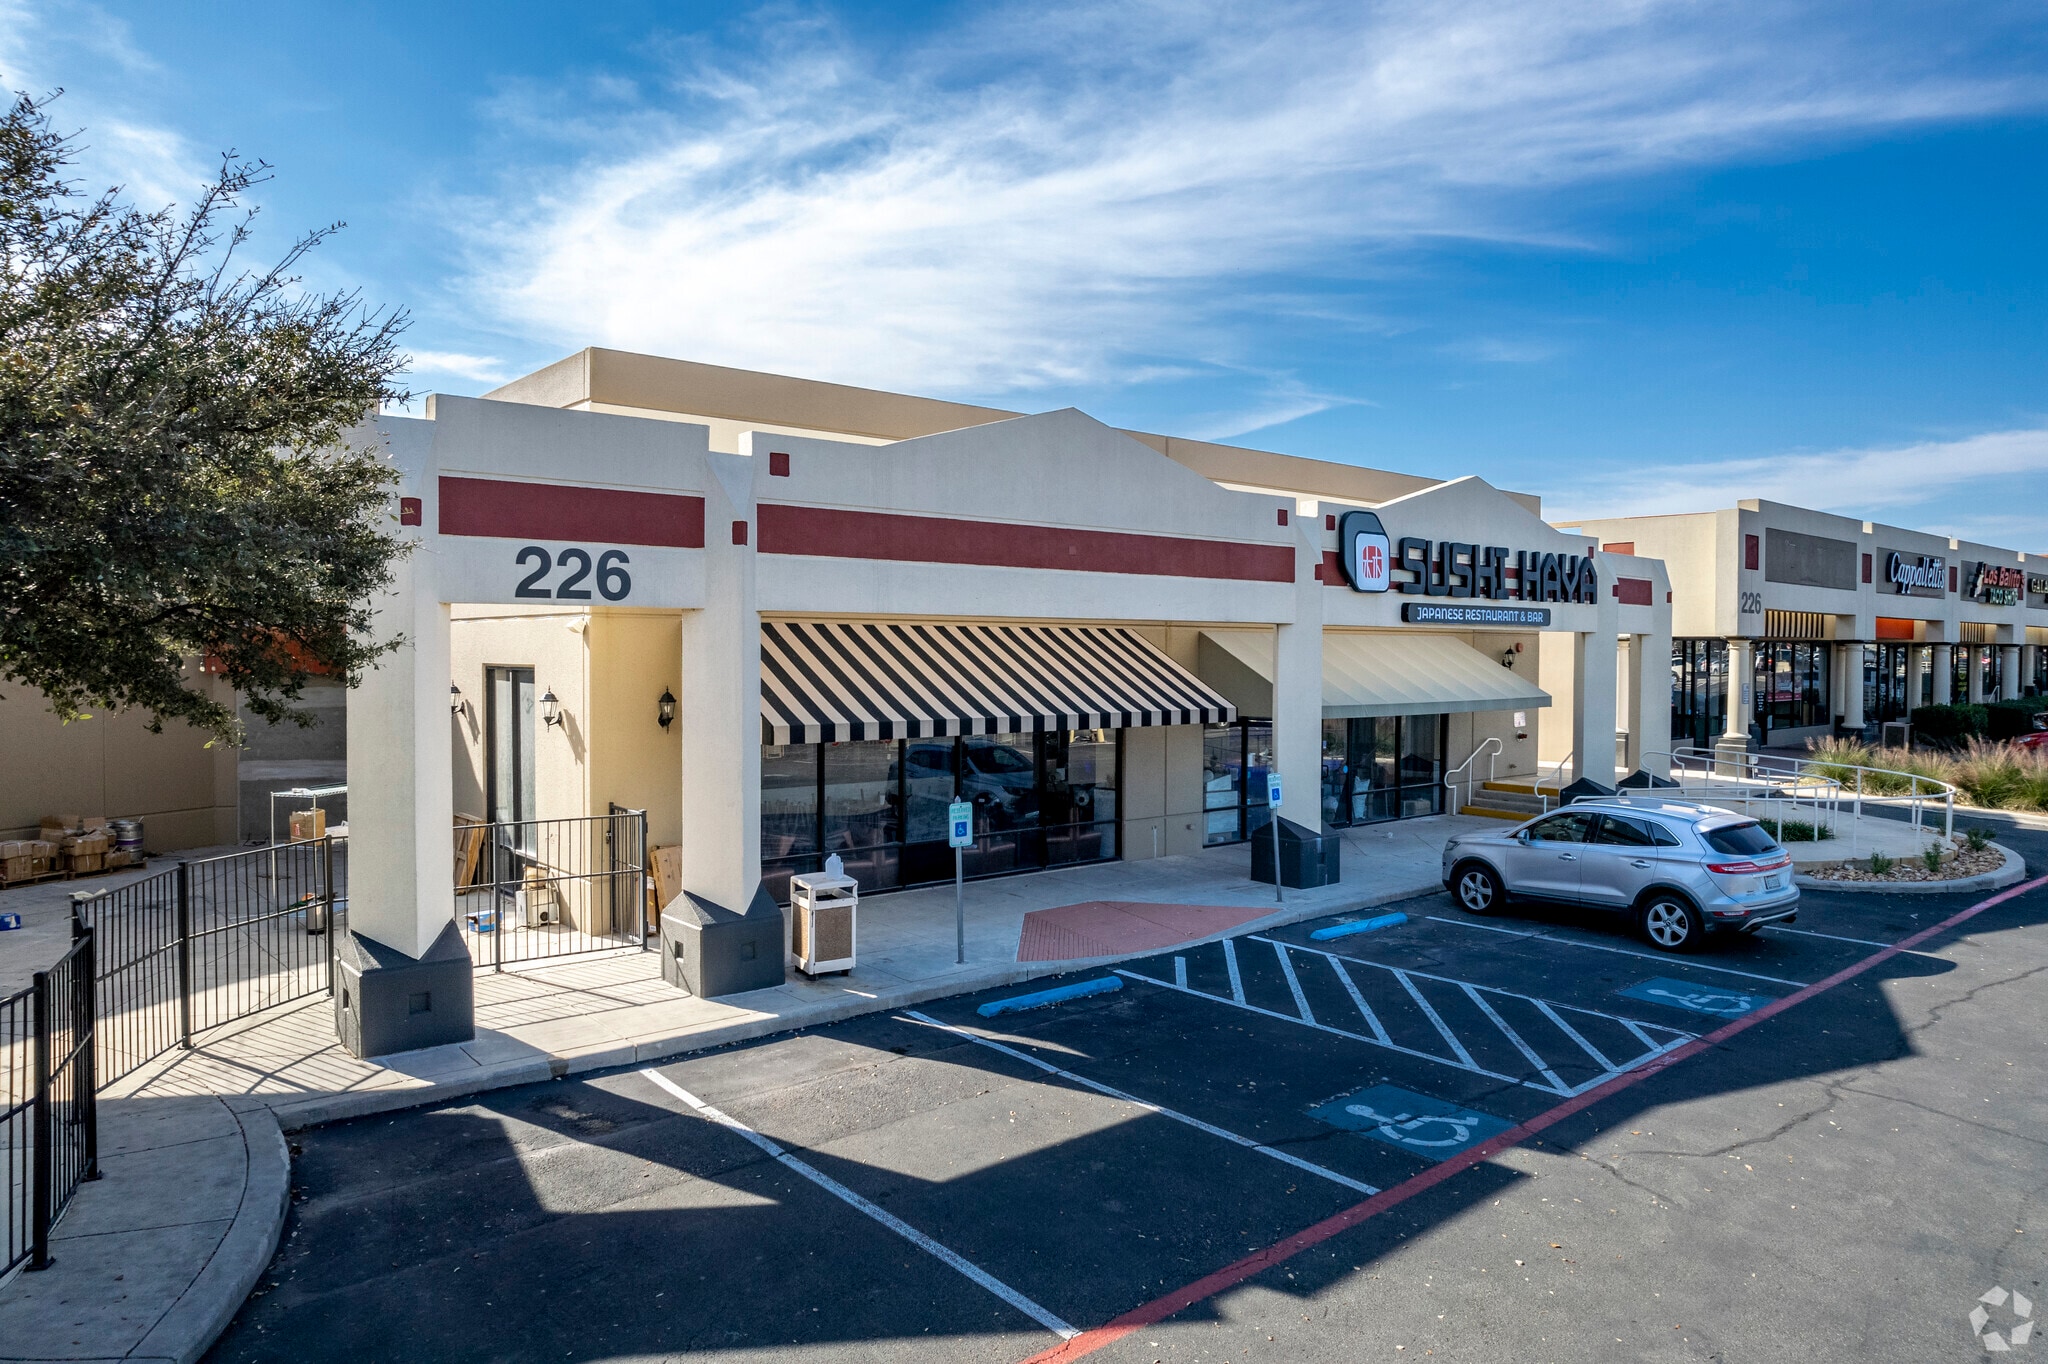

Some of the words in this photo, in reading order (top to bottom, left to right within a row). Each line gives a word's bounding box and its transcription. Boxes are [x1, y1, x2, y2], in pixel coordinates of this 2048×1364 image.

[515, 546, 631, 601] 226
[1400, 537, 1509, 600] SUSHI
[1518, 550, 1597, 604] HAYA
[1984, 562, 1998, 585] Los
[1416, 606, 1464, 621] JAPANESE
[1465, 608, 1520, 623] RESTAURANT
[1520, 611, 1526, 623] &
[1527, 611, 1544, 623] BAR
[1741, 591, 1762, 615] 226
